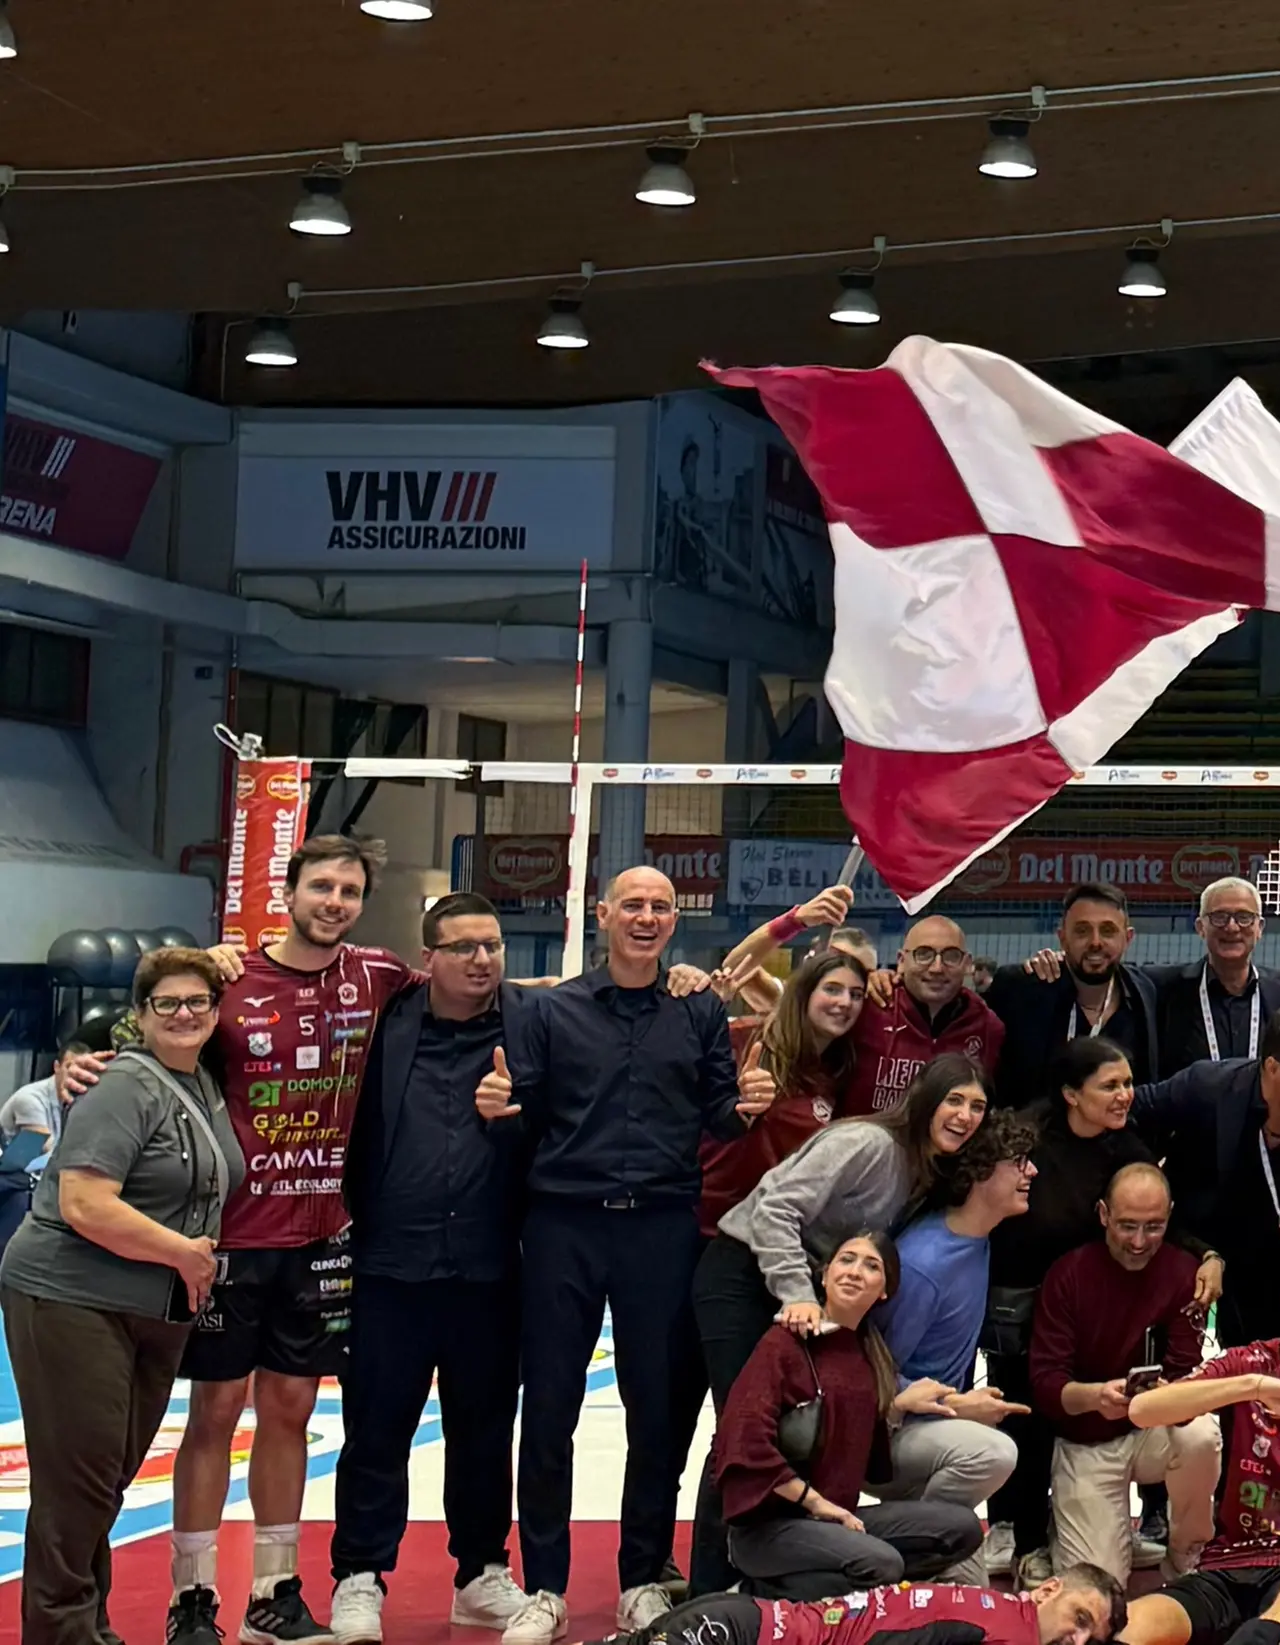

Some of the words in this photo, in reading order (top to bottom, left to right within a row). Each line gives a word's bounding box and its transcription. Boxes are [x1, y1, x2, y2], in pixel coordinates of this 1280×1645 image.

[326, 471, 442, 521] VHV
[0, 496, 56, 535] RENA
[327, 526, 526, 550] ASSICURAZIONI
[645, 849, 721, 879] onte
[1018, 852, 1064, 884] Del
[1070, 853, 1164, 885] Monte
[299, 1014, 316, 1036] 5
[288, 1074, 357, 1092] DOMOTEK
[253, 1111, 319, 1129] GOLD
[250, 1147, 345, 1172] CANALE
